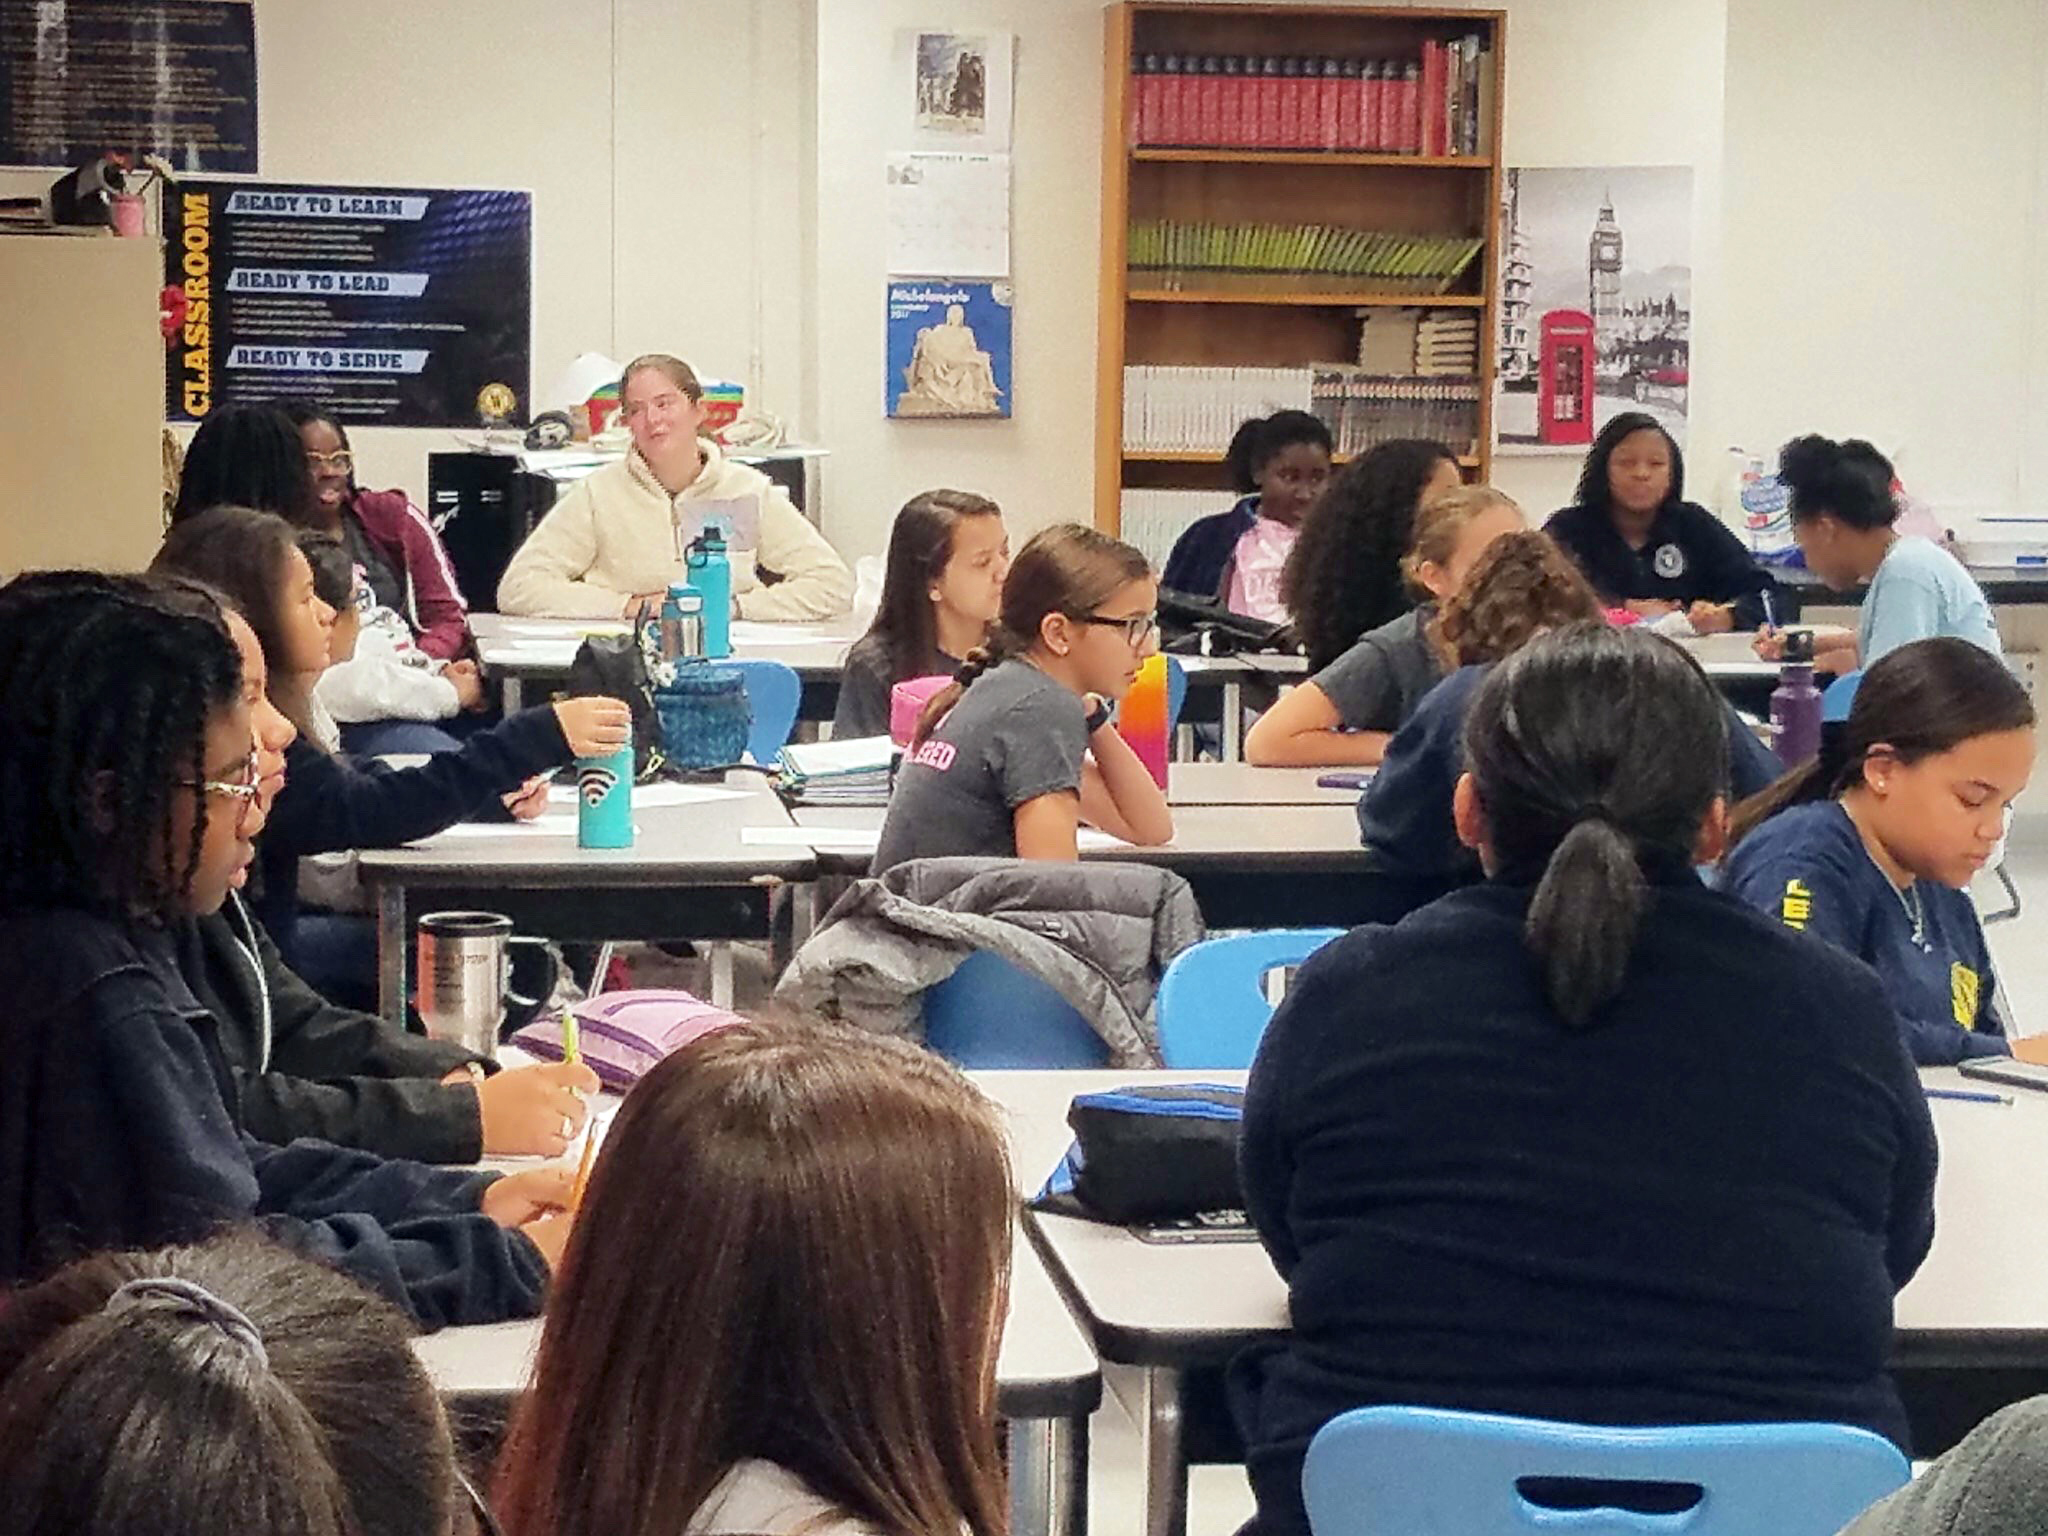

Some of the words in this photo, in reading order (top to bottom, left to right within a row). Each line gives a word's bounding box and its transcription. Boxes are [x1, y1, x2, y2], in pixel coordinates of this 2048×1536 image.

[234, 193, 299, 212] READY
[305, 196, 332, 213] TO
[339, 197, 403, 215] LEARN
[236, 271, 301, 289] READY
[306, 273, 333, 291] TO
[339, 275, 390, 292] LEAD
[183, 192, 211, 417] CLASSROOM
[236, 349, 301, 366] READY
[306, 350, 333, 367] TO
[339, 352, 403, 369] SERVE
